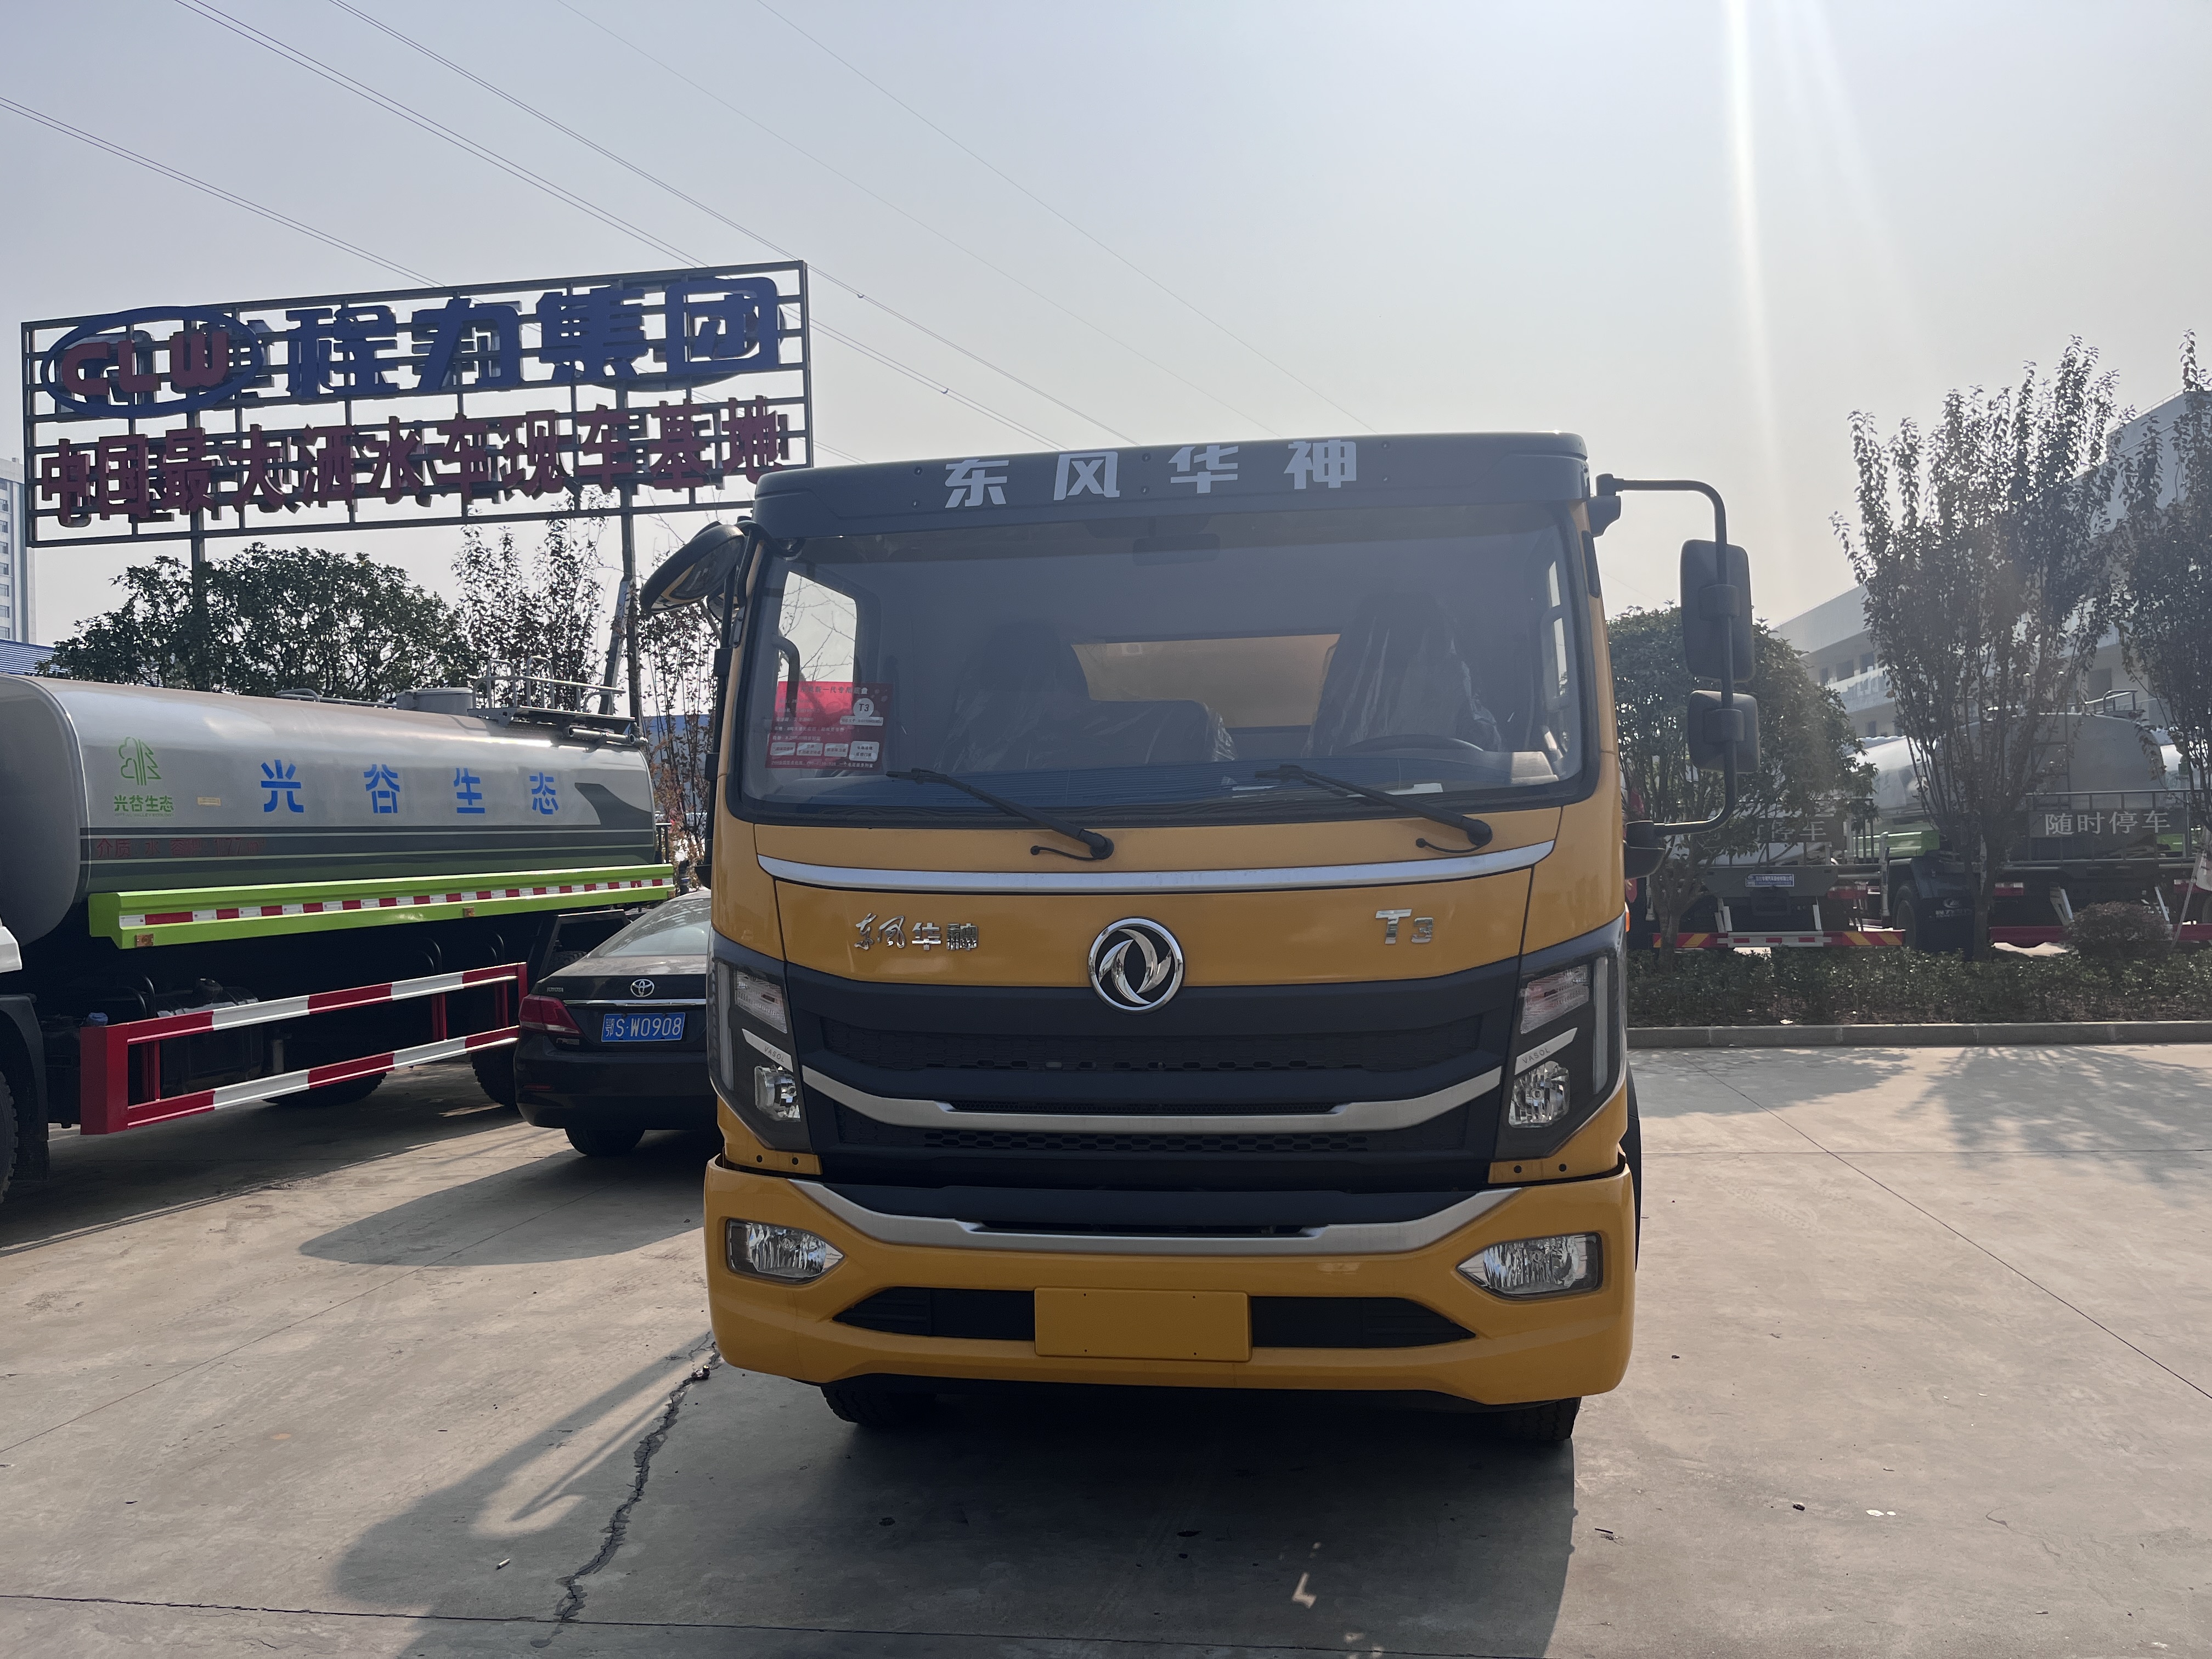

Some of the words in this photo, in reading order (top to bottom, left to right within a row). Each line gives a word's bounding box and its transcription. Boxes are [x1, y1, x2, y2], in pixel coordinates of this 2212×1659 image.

[285, 277, 781, 398] 程力集团
[945, 439, 1357, 509] 东风华神
[859, 703, 870, 712] T3
[261, 759, 559, 815] 光谷生态
[114, 794, 174, 812] 光谷生态
[2045, 810, 2171, 836] 随时停车
[1375, 909, 1434, 944] T3
[764, 1046, 785, 1063] VASOL
[1522, 1047, 1551, 1064] VASOL
